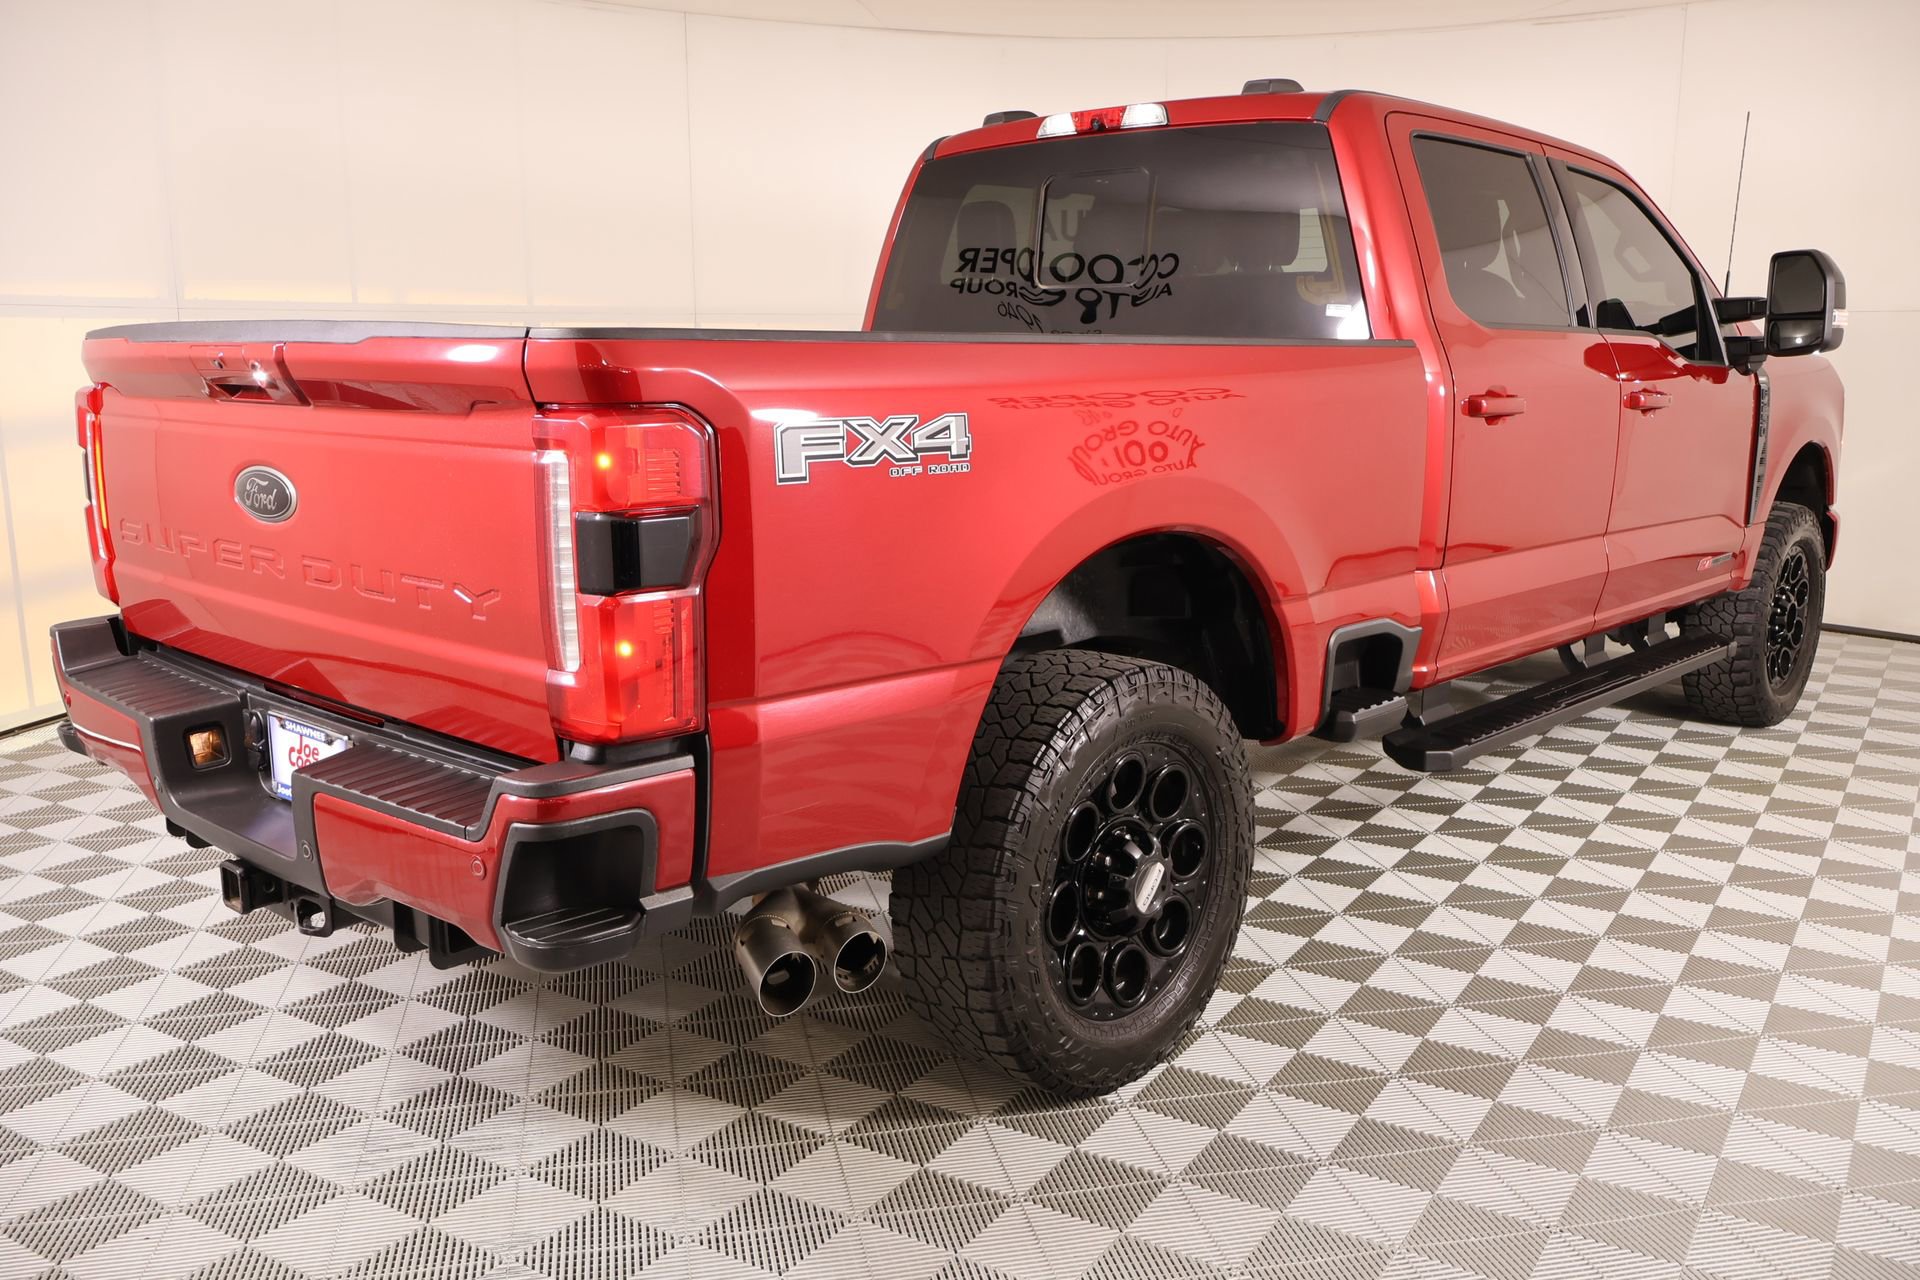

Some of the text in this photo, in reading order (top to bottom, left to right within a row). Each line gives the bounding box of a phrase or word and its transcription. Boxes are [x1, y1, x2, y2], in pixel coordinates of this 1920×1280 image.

[774, 412, 972, 485] FX4
[889, 463, 971, 477] OFF ROAD
[245, 477, 278, 510] Ford
[119, 517, 502, 622] SUPER DUTY
[284, 719, 327, 741] SHAWNEE
[288, 746, 313, 769] Coo
[297, 735, 320, 761] Joe
